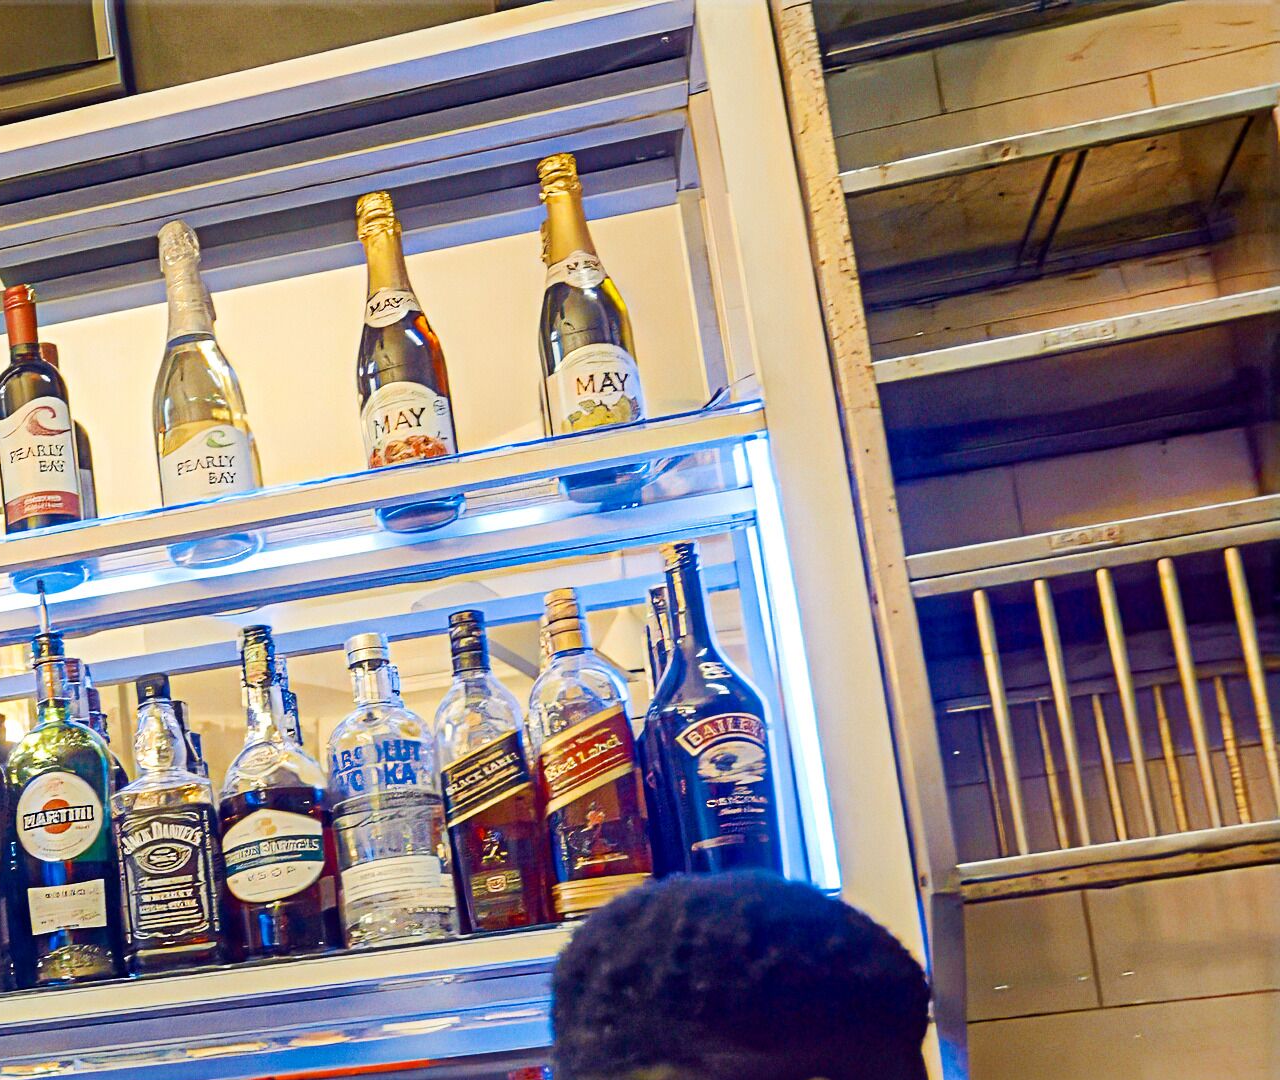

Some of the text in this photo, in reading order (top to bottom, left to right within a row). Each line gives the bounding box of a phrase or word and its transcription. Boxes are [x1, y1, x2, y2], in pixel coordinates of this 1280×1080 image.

[576, 372, 629, 396] MAY
[373, 407, 426, 439] MAY
[208, 471, 237, 485] BAY
